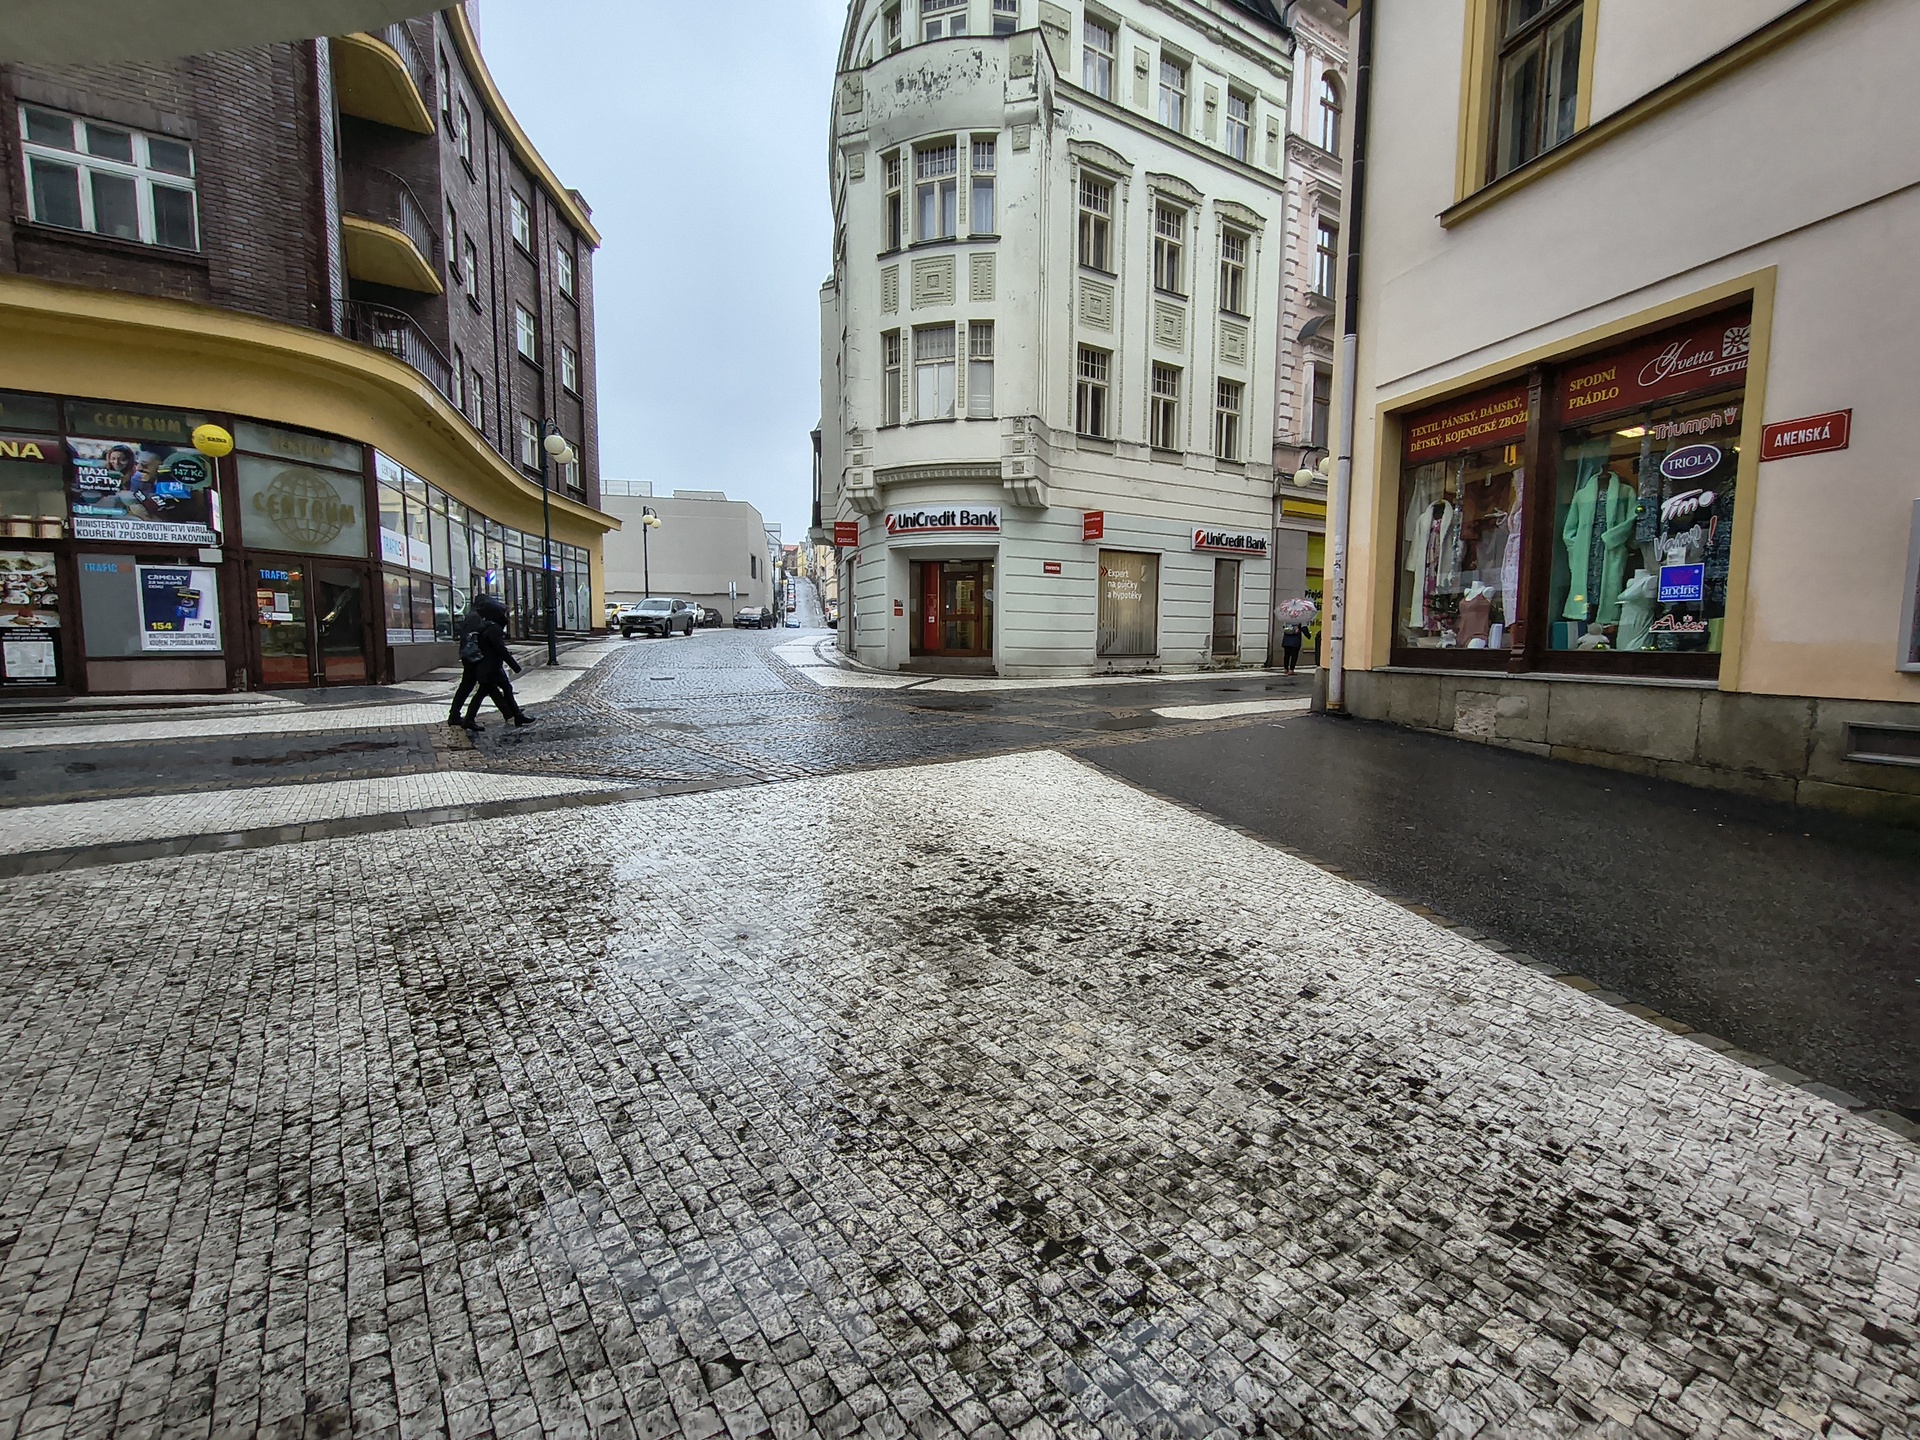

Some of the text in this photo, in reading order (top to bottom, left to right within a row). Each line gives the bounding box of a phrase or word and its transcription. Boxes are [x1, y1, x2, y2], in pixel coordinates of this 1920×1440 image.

[1638, 339, 1714, 386] Yvetta
[1570, 366, 1617, 392] SPODNÍ
[1568, 386, 1619, 410] PRÁDLO
[94, 412, 181, 434] CENTRUM
[1411, 396, 1522, 438] TEXTIL PÁNSKÝ, DÁMSKÝ,
[1653, 412, 1722, 440] Triumph
[1410, 436, 1443, 452] DĚTSKÝ,
[1445, 419, 1498, 443] KOJENECKÉ
[1774, 421, 1831, 448] ANENSKÁ
[79, 466, 108, 476] MAXI
[1668, 453, 1713, 470] TRIOLA
[174, 468, 189, 476] 147
[253, 491, 356, 524] CENTRUM
[76, 519, 131, 530] MINISTERSTVO
[898, 510, 998, 529] UniCredit Bank
[76, 528, 117, 539] KOUŘENÍ
[119, 530, 169, 541] ZPŮSOBUJE
[1206, 532, 1267, 551] UniCredit Bank
[1107, 569, 1129, 578] Expert
[1107, 580, 1139, 590] na půjčky
[1113, 590, 1143, 601] hypotéky
[151, 622, 173, 630] 154
